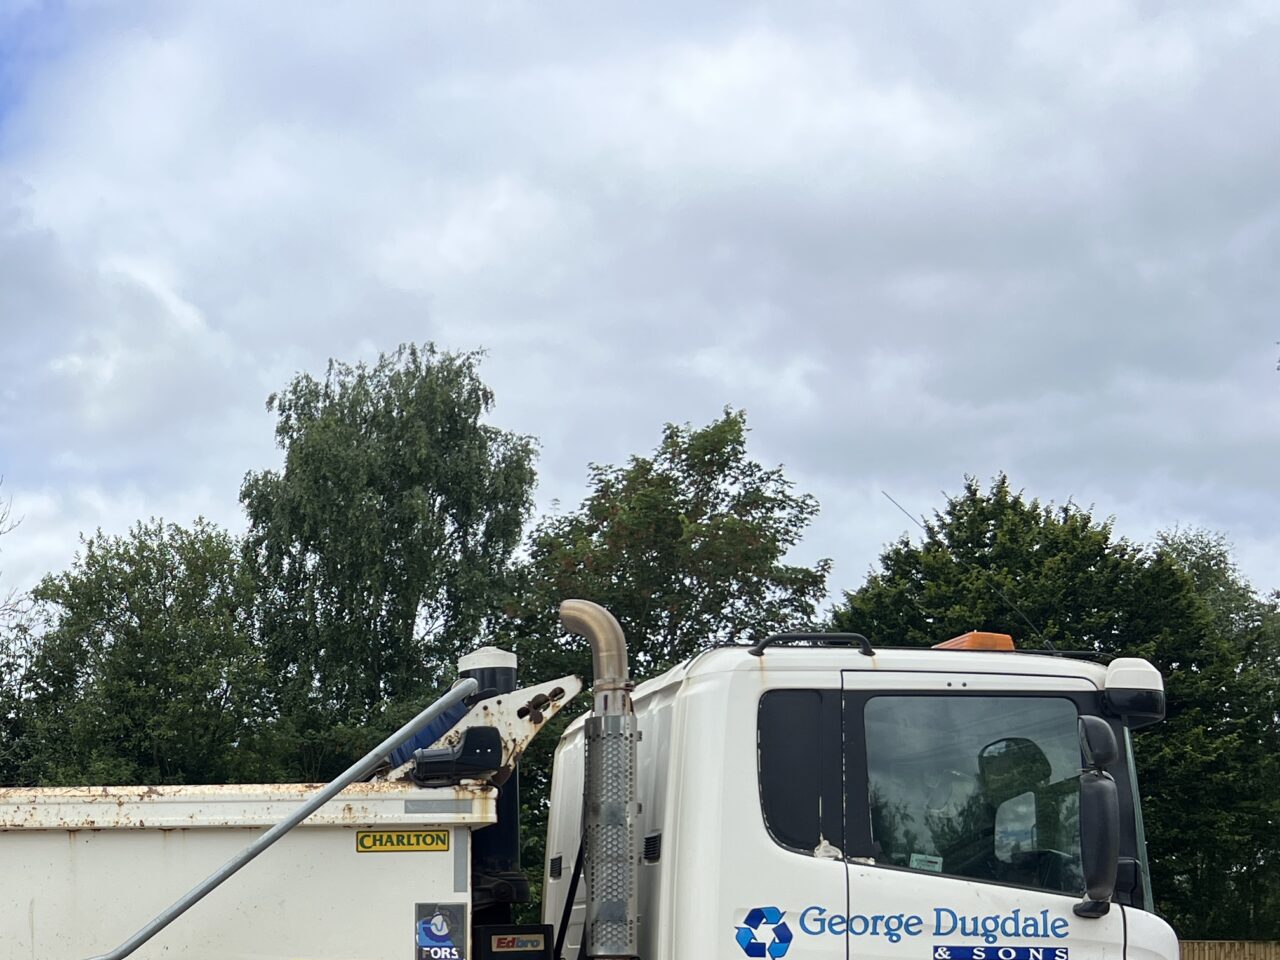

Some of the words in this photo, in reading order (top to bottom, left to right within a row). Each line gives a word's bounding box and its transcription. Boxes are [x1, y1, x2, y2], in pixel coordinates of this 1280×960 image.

[359, 831, 446, 849] CHARLTON
[799, 906, 923, 943] George
[933, 907, 1070, 944] Dugdale
[422, 947, 459, 959] FORS
[934, 946, 952, 960] &
